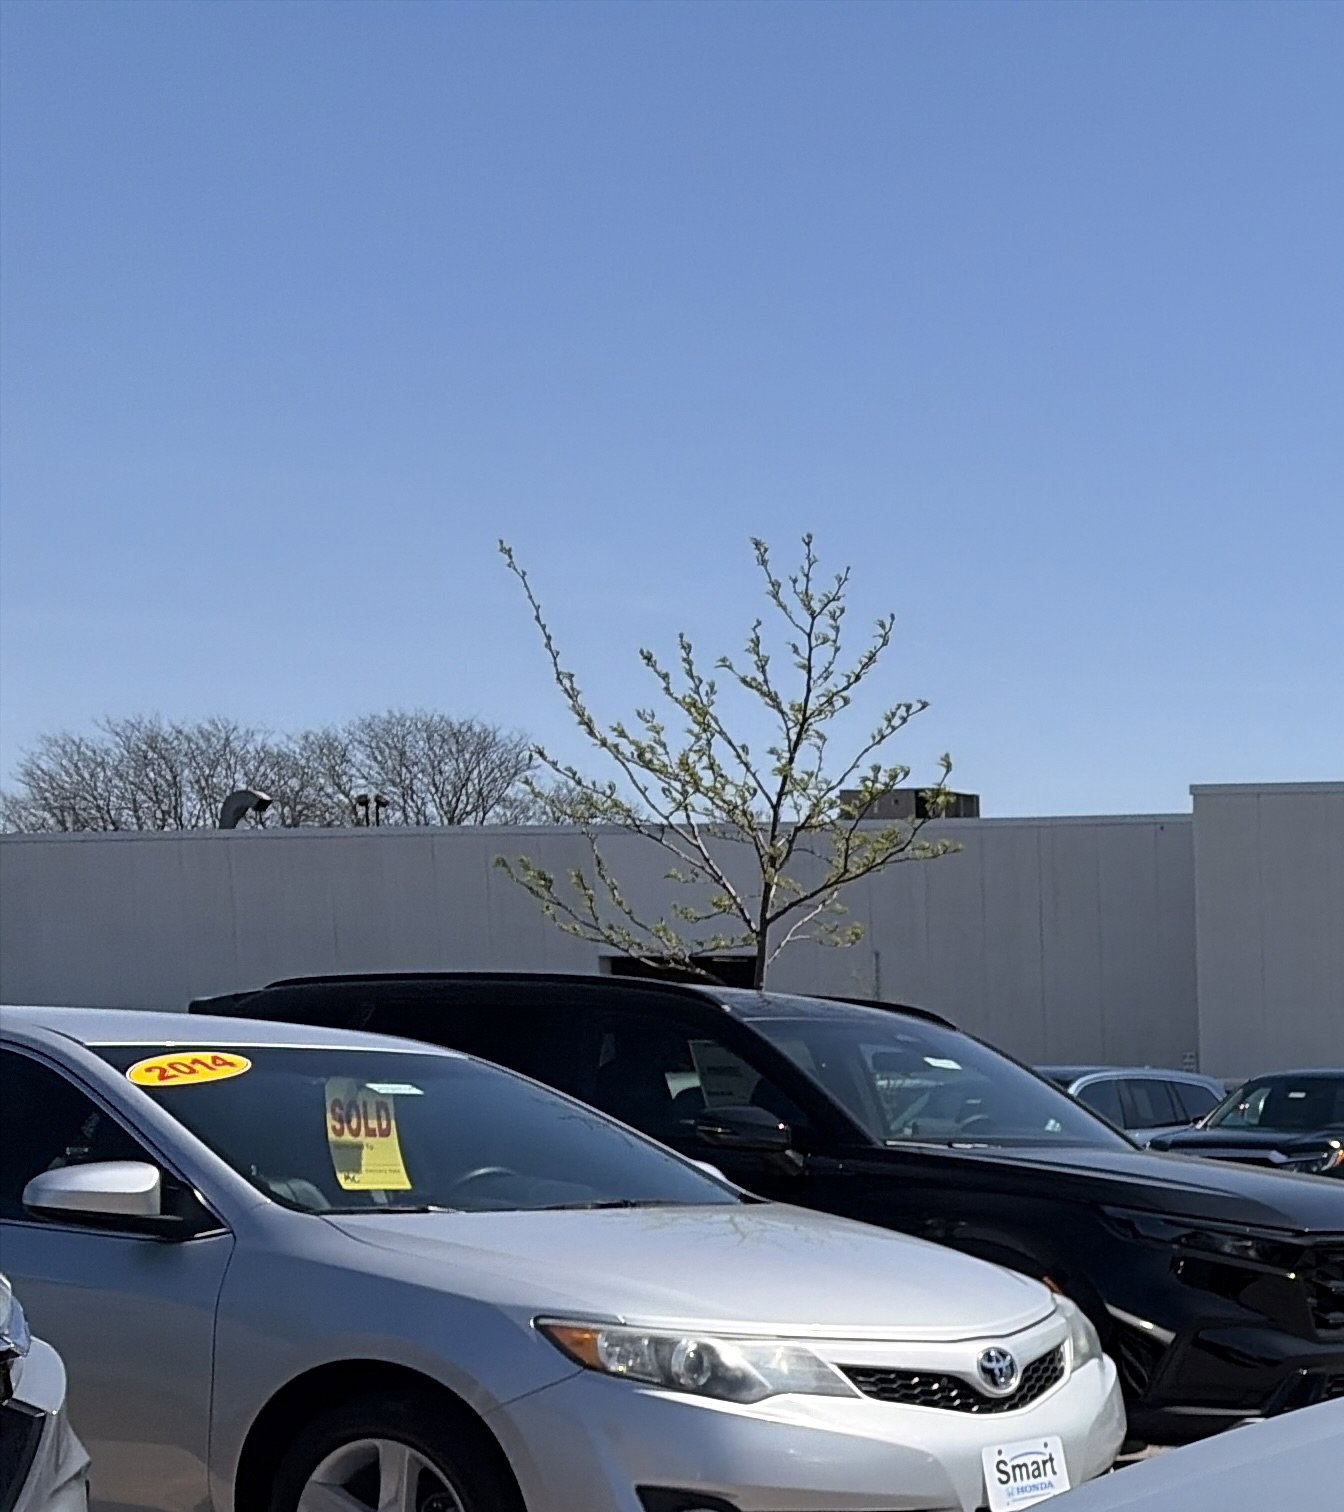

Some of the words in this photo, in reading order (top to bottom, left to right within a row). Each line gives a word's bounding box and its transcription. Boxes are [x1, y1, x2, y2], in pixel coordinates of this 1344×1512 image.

[144, 1055, 236, 1081] 2014
[330, 1098, 391, 1138] SOLD
[995, 1452, 1057, 1485] Smart
[1016, 1481, 1054, 1495] HONDA
